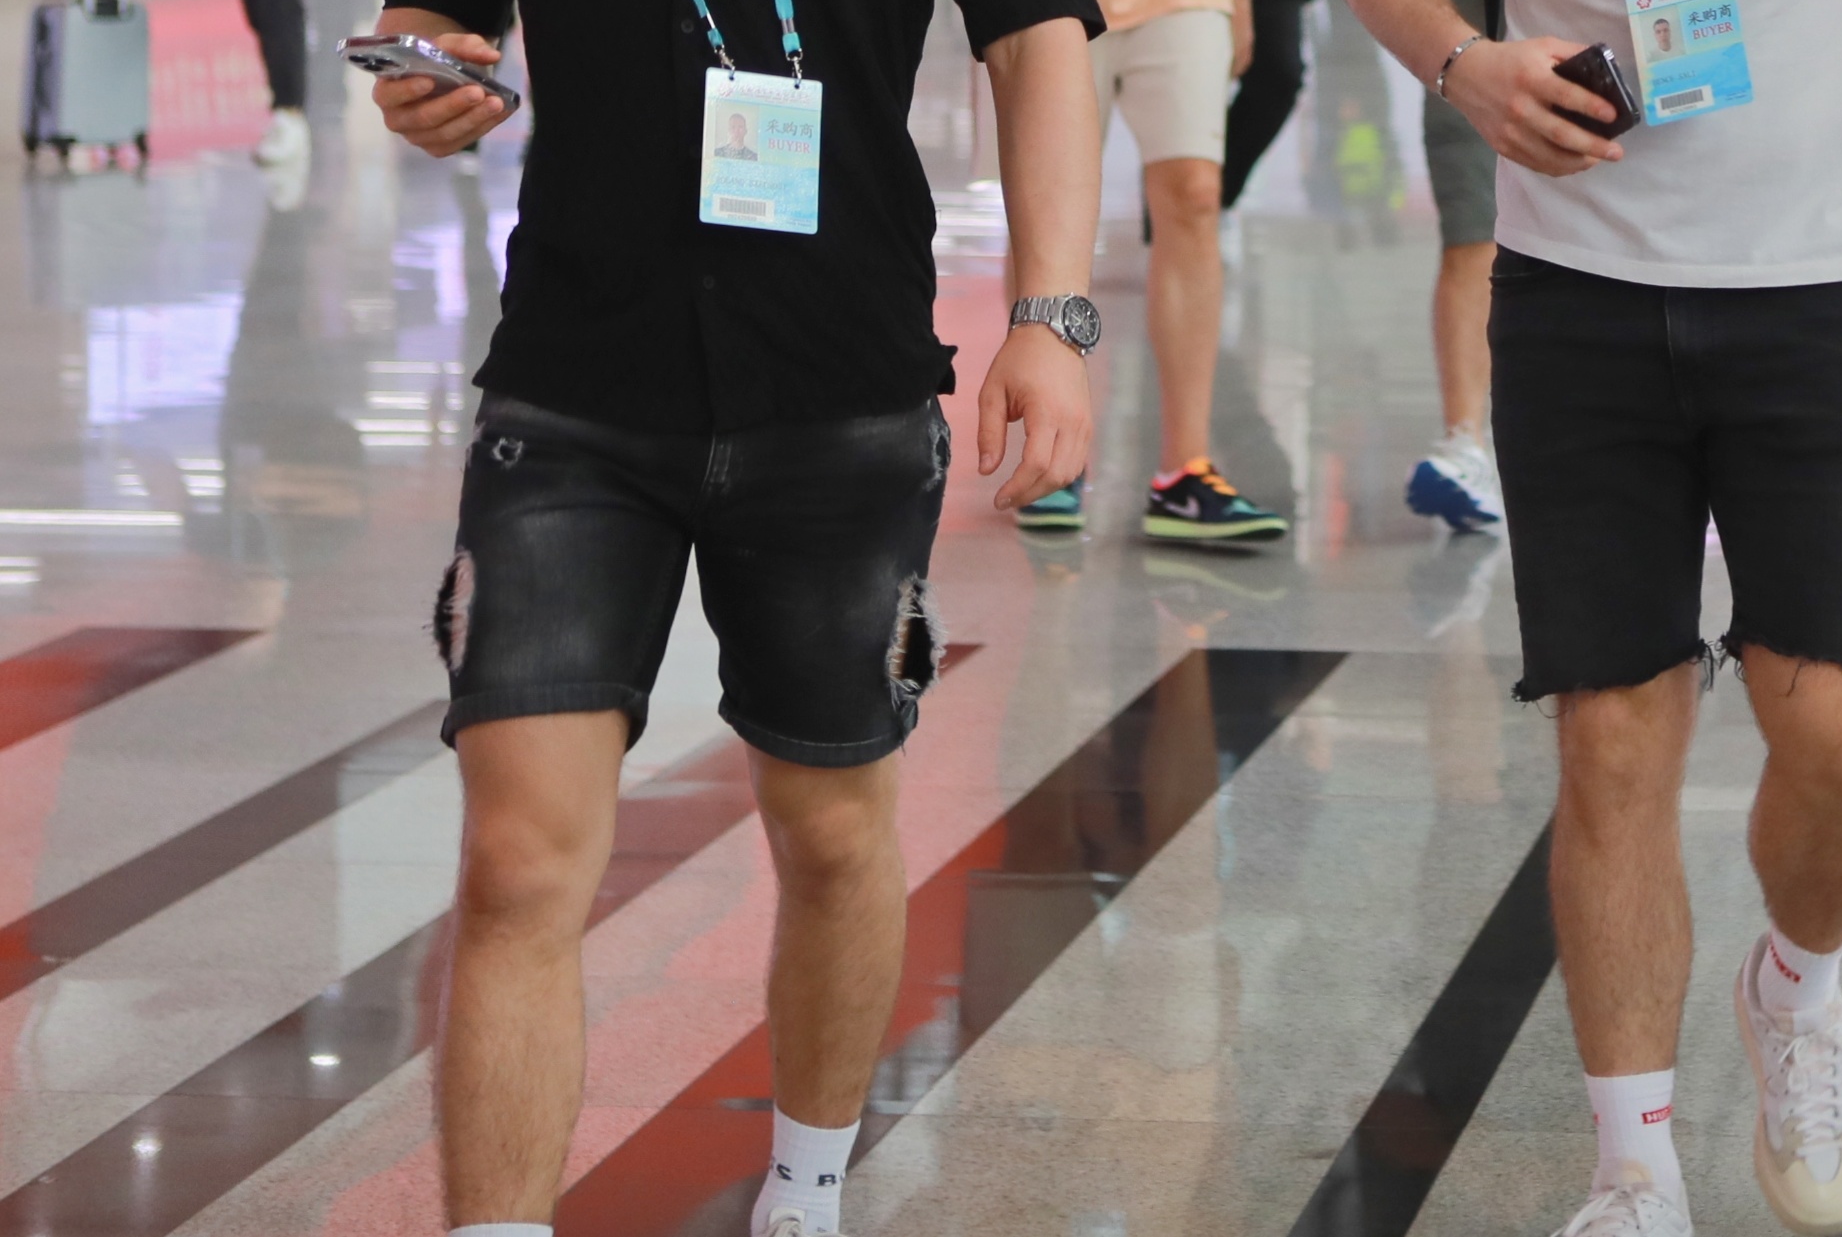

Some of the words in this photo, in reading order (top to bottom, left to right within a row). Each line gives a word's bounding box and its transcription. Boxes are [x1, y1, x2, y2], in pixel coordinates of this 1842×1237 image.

[1688, 4, 1732, 26] 采购商
[1693, 22, 1734, 40] BUYER
[766, 119, 814, 139] 采购商
[768, 138, 811, 154] BUYER
